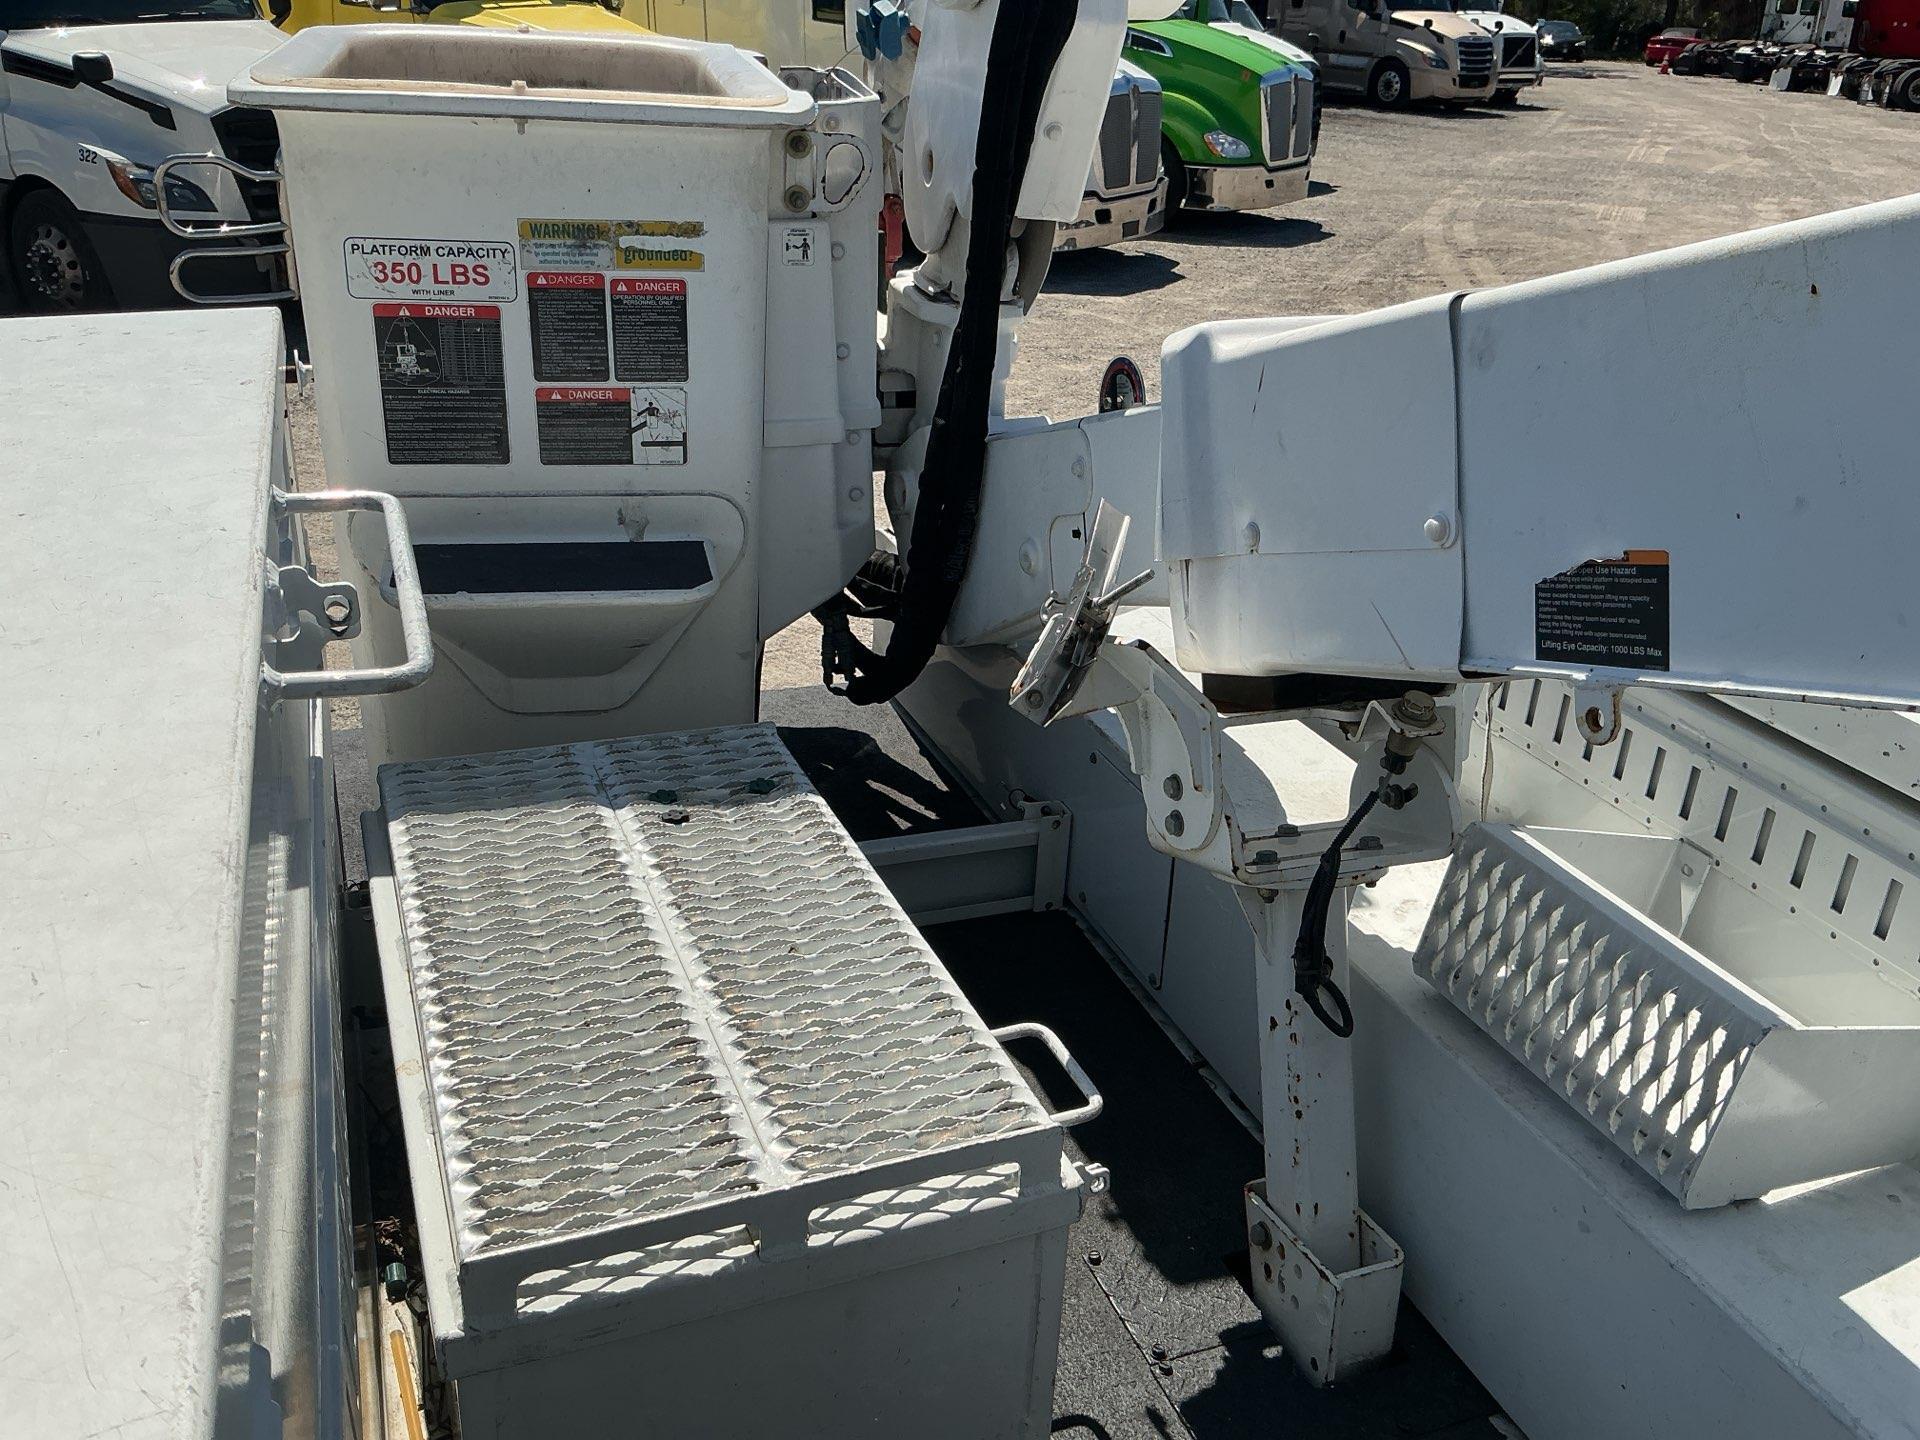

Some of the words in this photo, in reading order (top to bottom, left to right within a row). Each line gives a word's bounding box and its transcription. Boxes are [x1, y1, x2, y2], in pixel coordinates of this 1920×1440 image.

[78, 148, 98, 164] 322
[529, 222, 600, 240] WARNING!
[351, 243, 431, 257] PLATFORM
[435, 246, 508, 259] CAPACITY
[373, 261, 422, 284] 350
[432, 263, 490, 286] LBS
[548, 275, 595, 284] DANGER
[411, 288, 431, 296] WITH
[635, 282, 680, 292] DANGER
[425, 306, 475, 316] DANGER
[568, 390, 613, 400] DANGER
[1595, 566, 1608, 574] Use
[1610, 566, 1636, 575] Hazard
[1541, 640, 1562, 651] Lifting
[1562, 641, 1576, 651] Eye
[1610, 645, 1629, 654] 1000
[1629, 645, 1645, 656] LBS
[1646, 647, 1663, 657] Max
